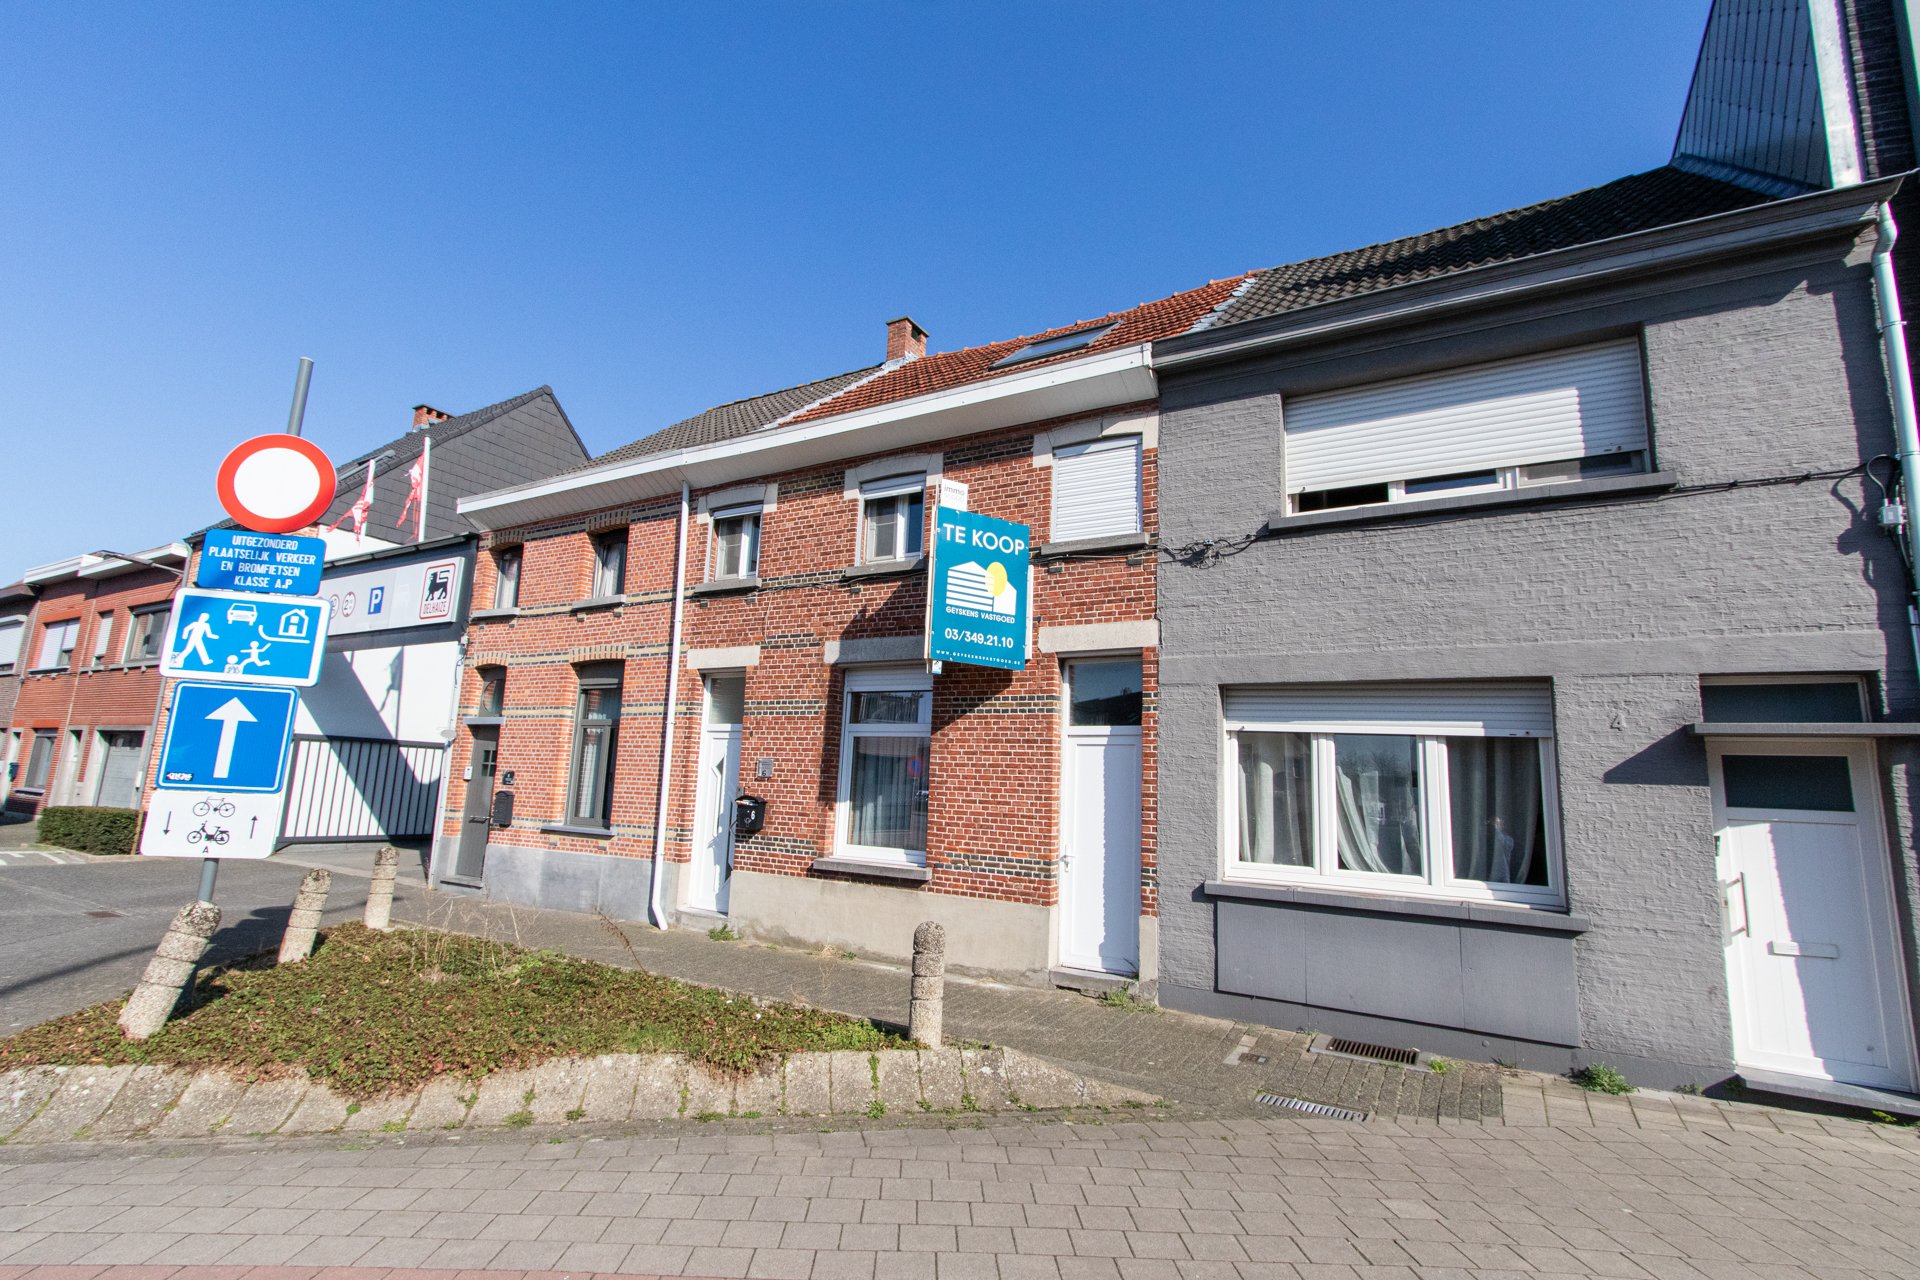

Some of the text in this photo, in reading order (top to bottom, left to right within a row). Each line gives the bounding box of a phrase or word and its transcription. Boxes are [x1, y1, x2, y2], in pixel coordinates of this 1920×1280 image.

[232, 535, 298, 550] UITGEZONDERD
[943, 523, 1025, 556] TE KOOP
[208, 546, 317, 565] PLAATSELIJK VERKEER
[220, 561, 301, 577] EN BROMFIETSEN
[234, 575, 271, 588] KLASSE
[370, 589, 381, 612] P
[422, 600, 447, 615] DELHAIZE
[945, 606, 1016, 624] GEYSKENS VASTGOED
[944, 627, 1014, 649] 03/349.21.10
[1610, 711, 1626, 731] 4
[751, 811, 756, 820] 6
[202, 845, 209, 854] A
